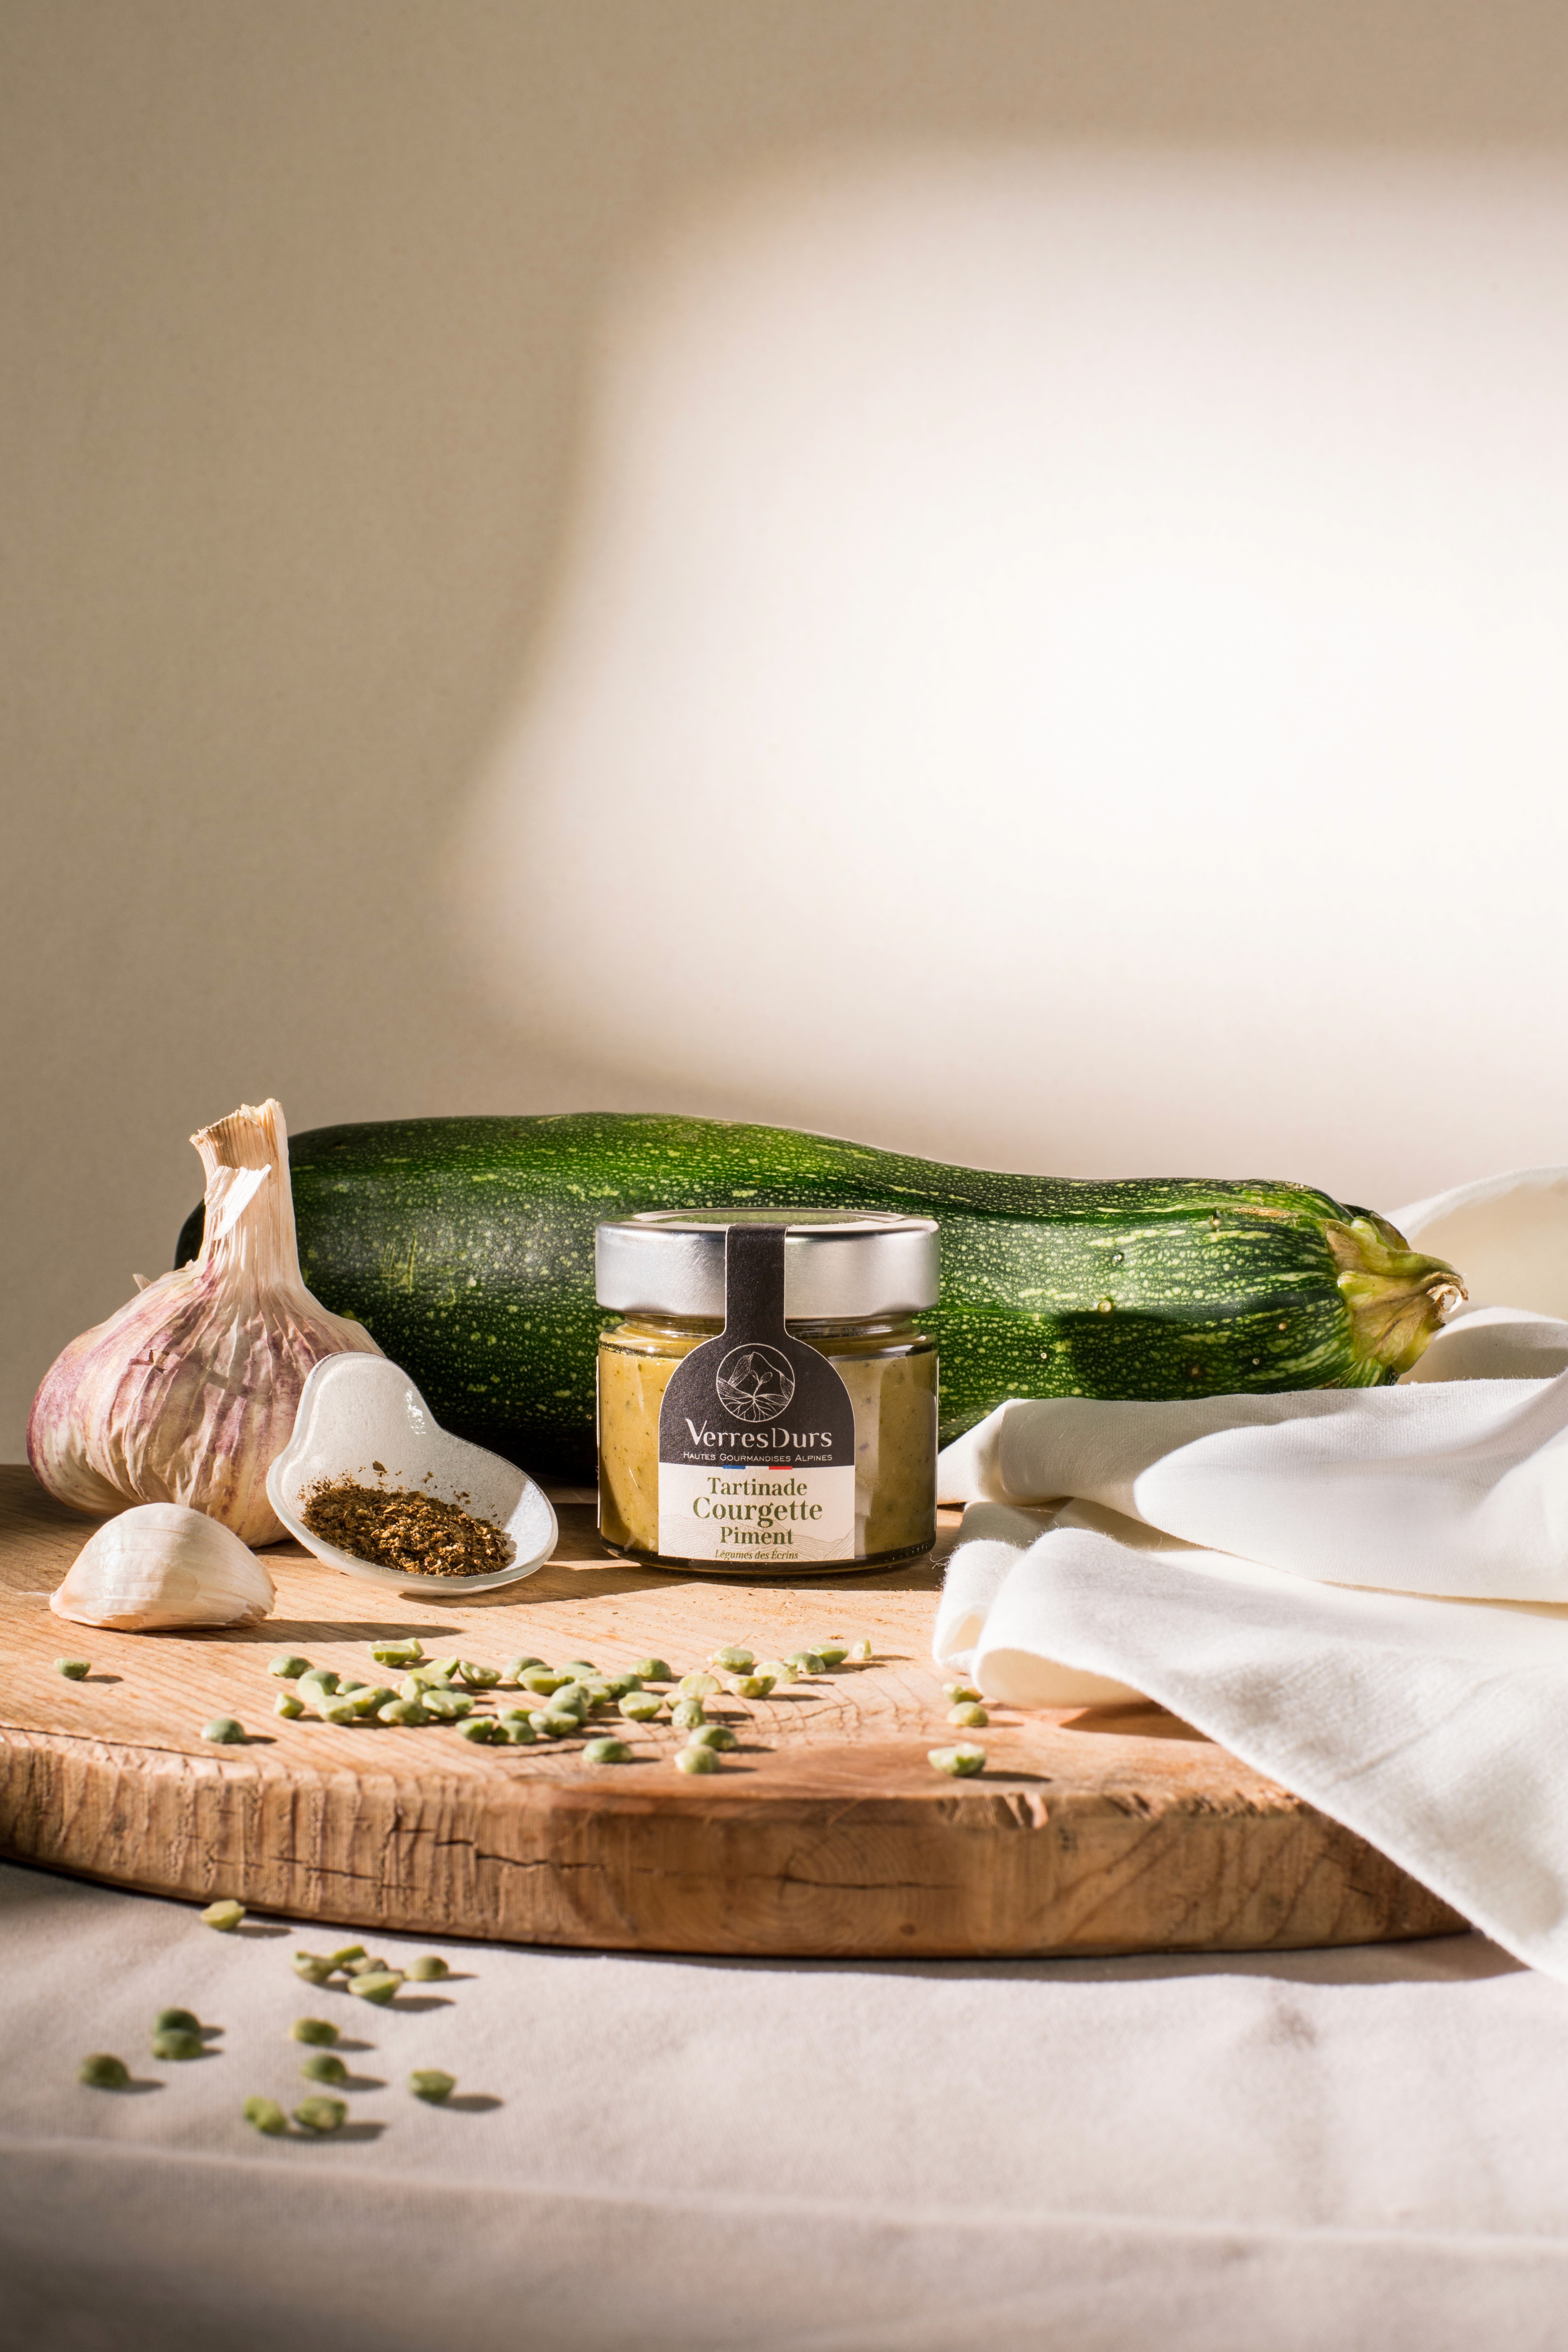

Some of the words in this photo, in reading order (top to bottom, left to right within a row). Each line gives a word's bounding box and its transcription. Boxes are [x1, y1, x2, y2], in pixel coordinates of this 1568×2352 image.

[685, 1418, 832, 1448] VerresDurs
[707, 1477, 808, 1496] Tartinade
[693, 1497, 823, 1527] Courgette
[720, 1526, 794, 1544] Piment
[715, 1549, 753, 1561] Légumes
[755, 1550, 769, 1559] des
[771, 1549, 798, 1560] Écrins
